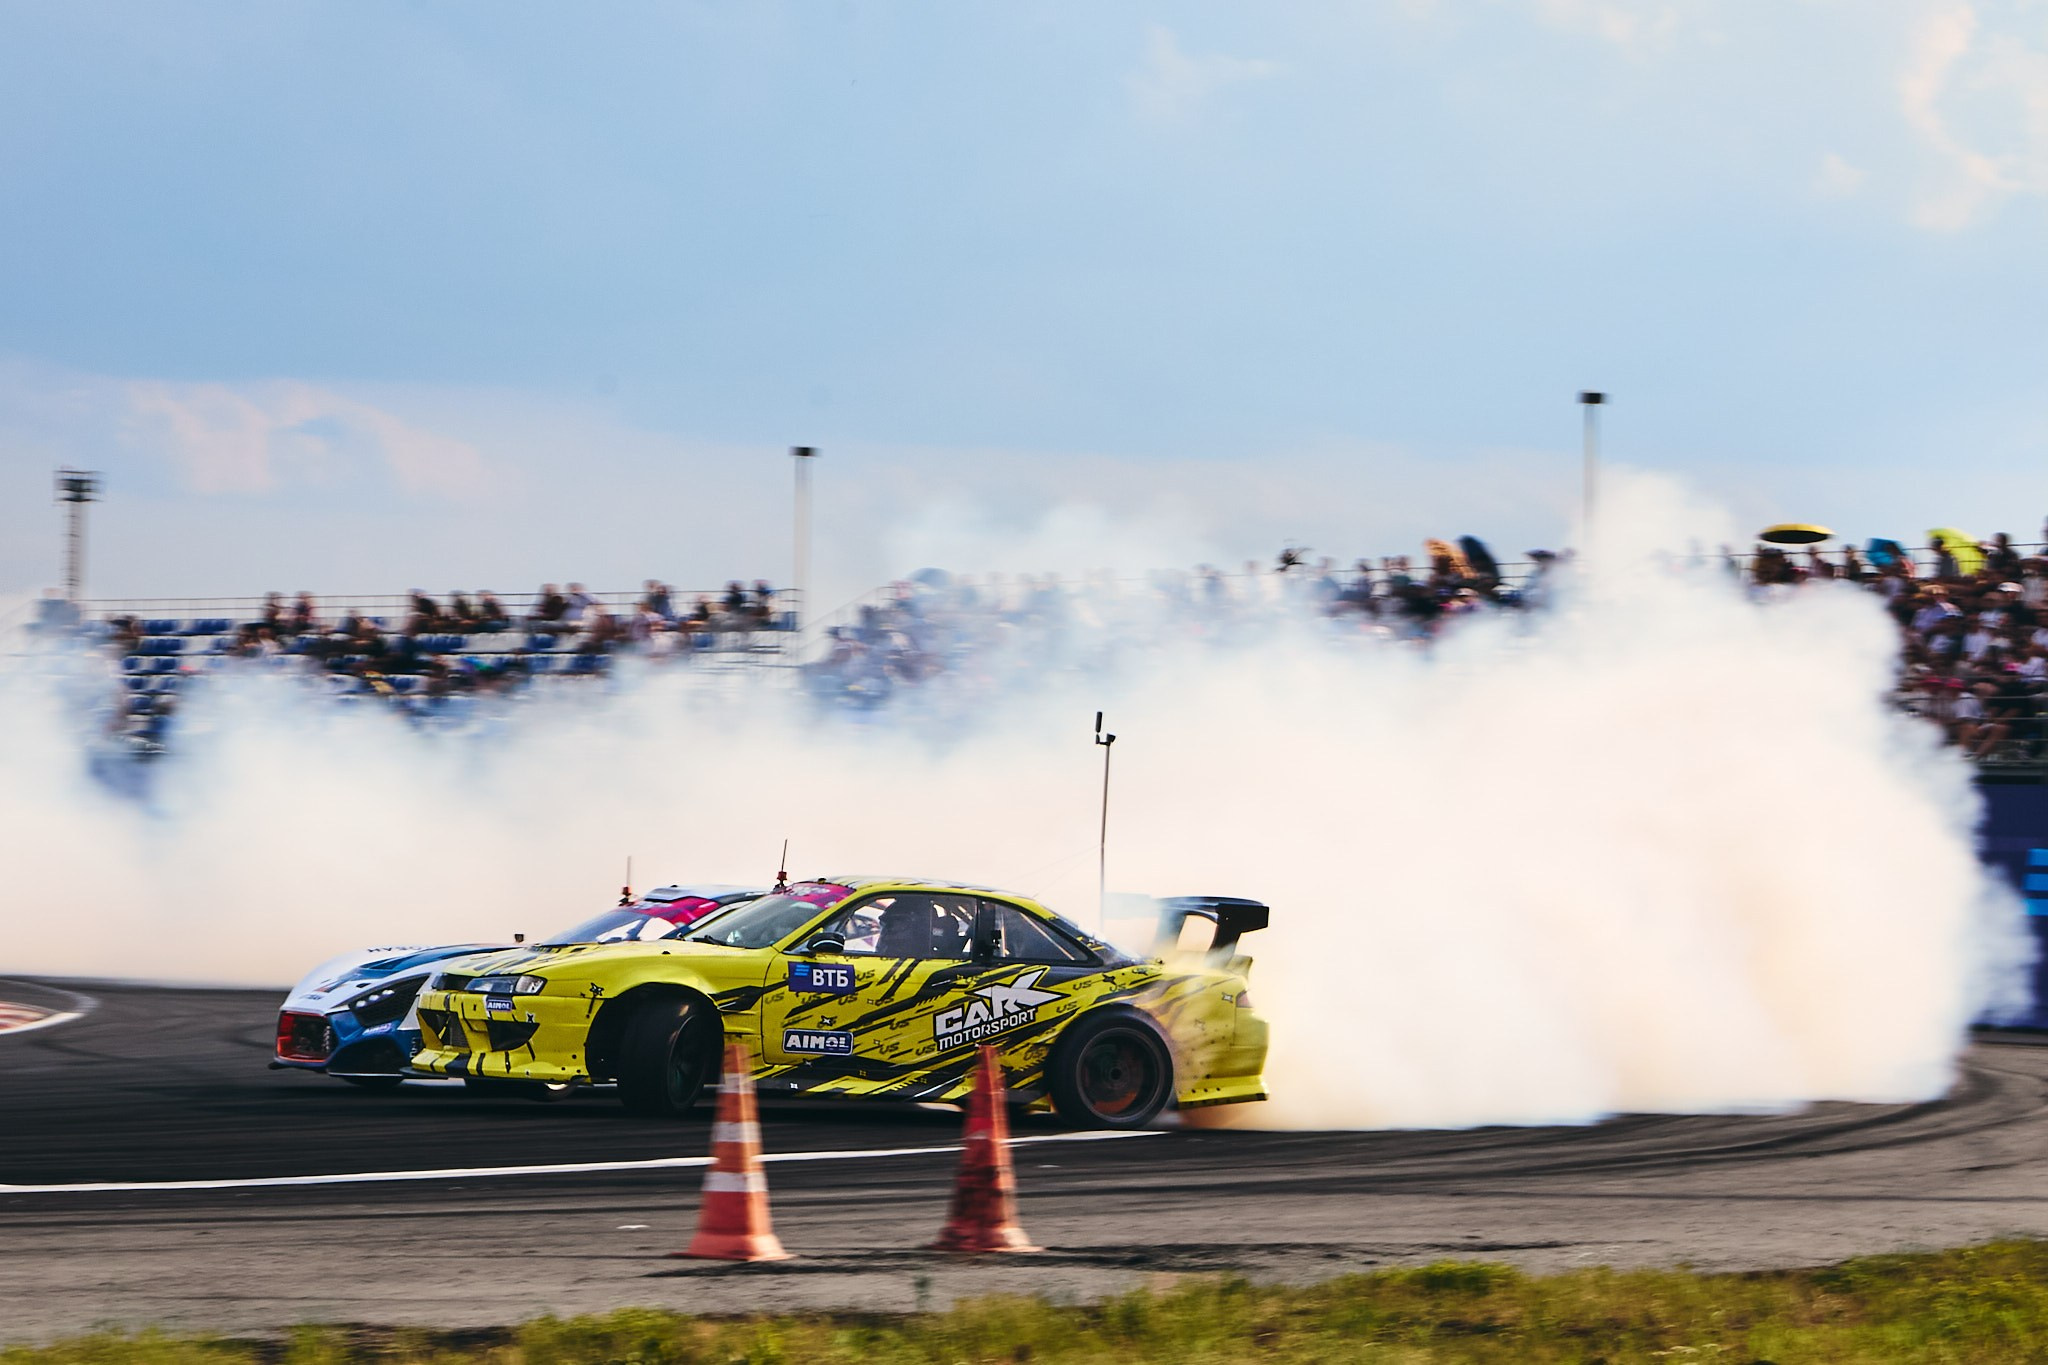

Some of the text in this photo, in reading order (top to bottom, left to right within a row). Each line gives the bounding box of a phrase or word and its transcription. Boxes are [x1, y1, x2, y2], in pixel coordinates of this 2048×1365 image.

[812, 968, 849, 988] ВТБ
[939, 1008, 1036, 1050] MOTORSPORT
[785, 1034, 849, 1050] AIMOL
